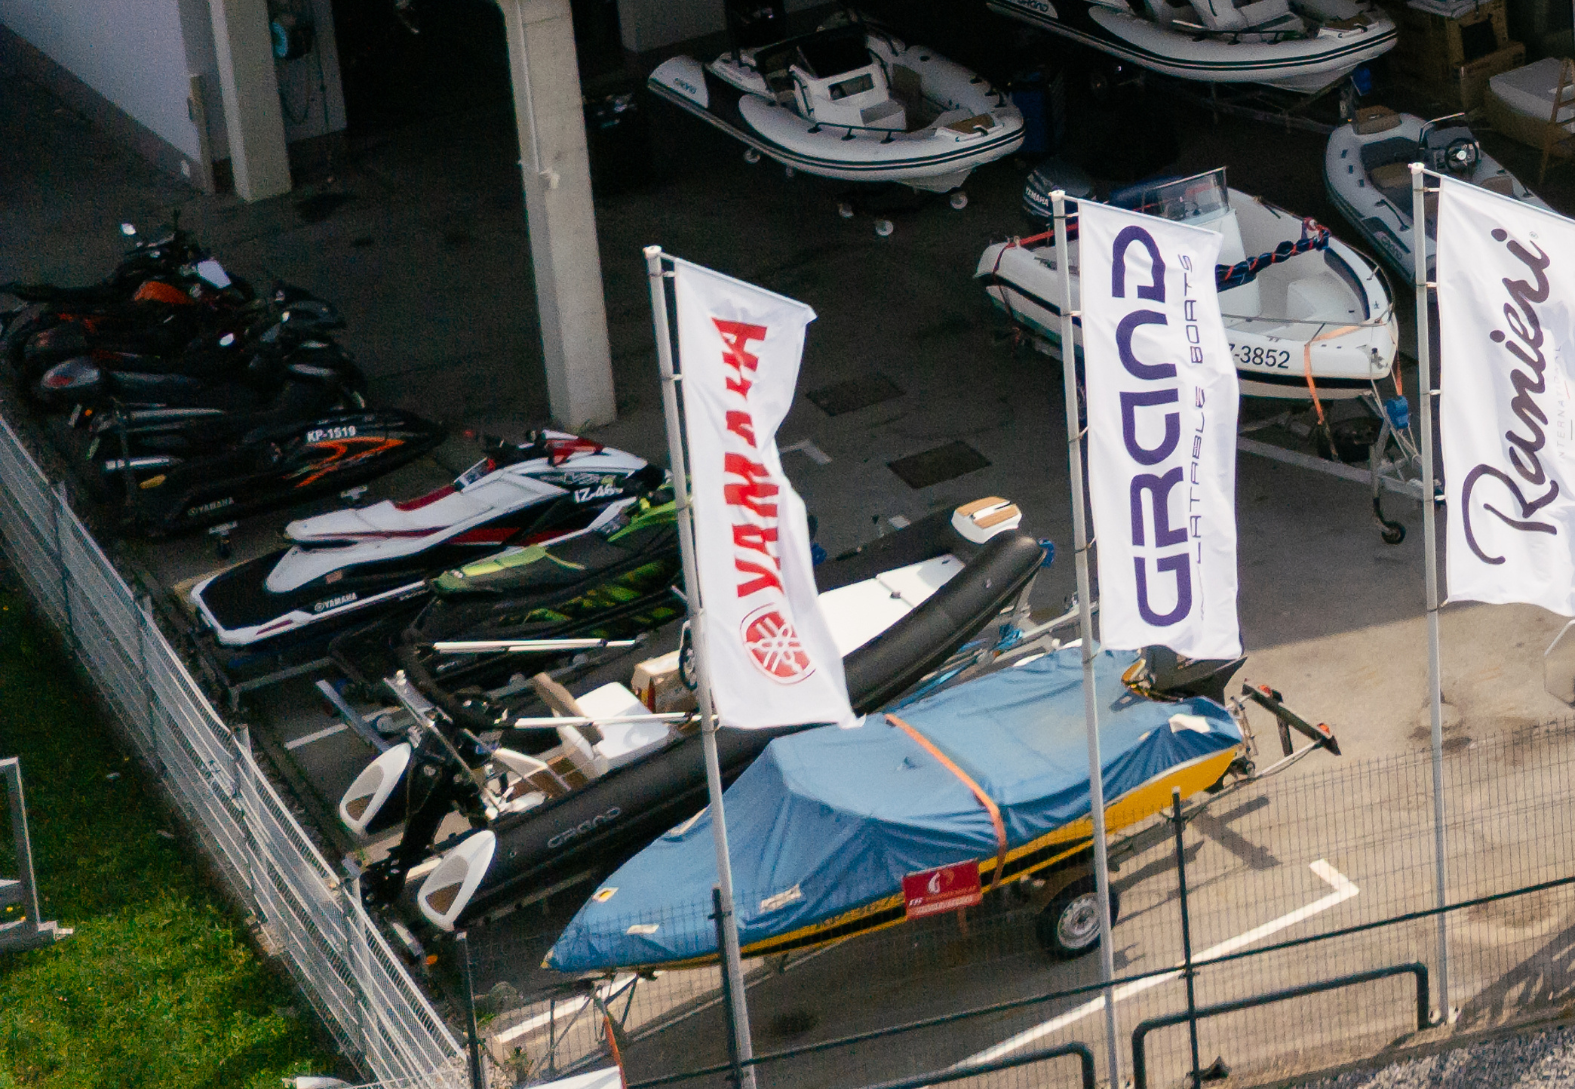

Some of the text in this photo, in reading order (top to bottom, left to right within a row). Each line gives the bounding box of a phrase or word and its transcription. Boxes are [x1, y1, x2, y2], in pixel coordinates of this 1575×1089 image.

[1178, 253, 1203, 364] BOATS
[1461, 228, 1559, 565] Ranieri
[1111, 225, 1192, 627] GRAND
[325, 592, 358, 609] YAMAHA
